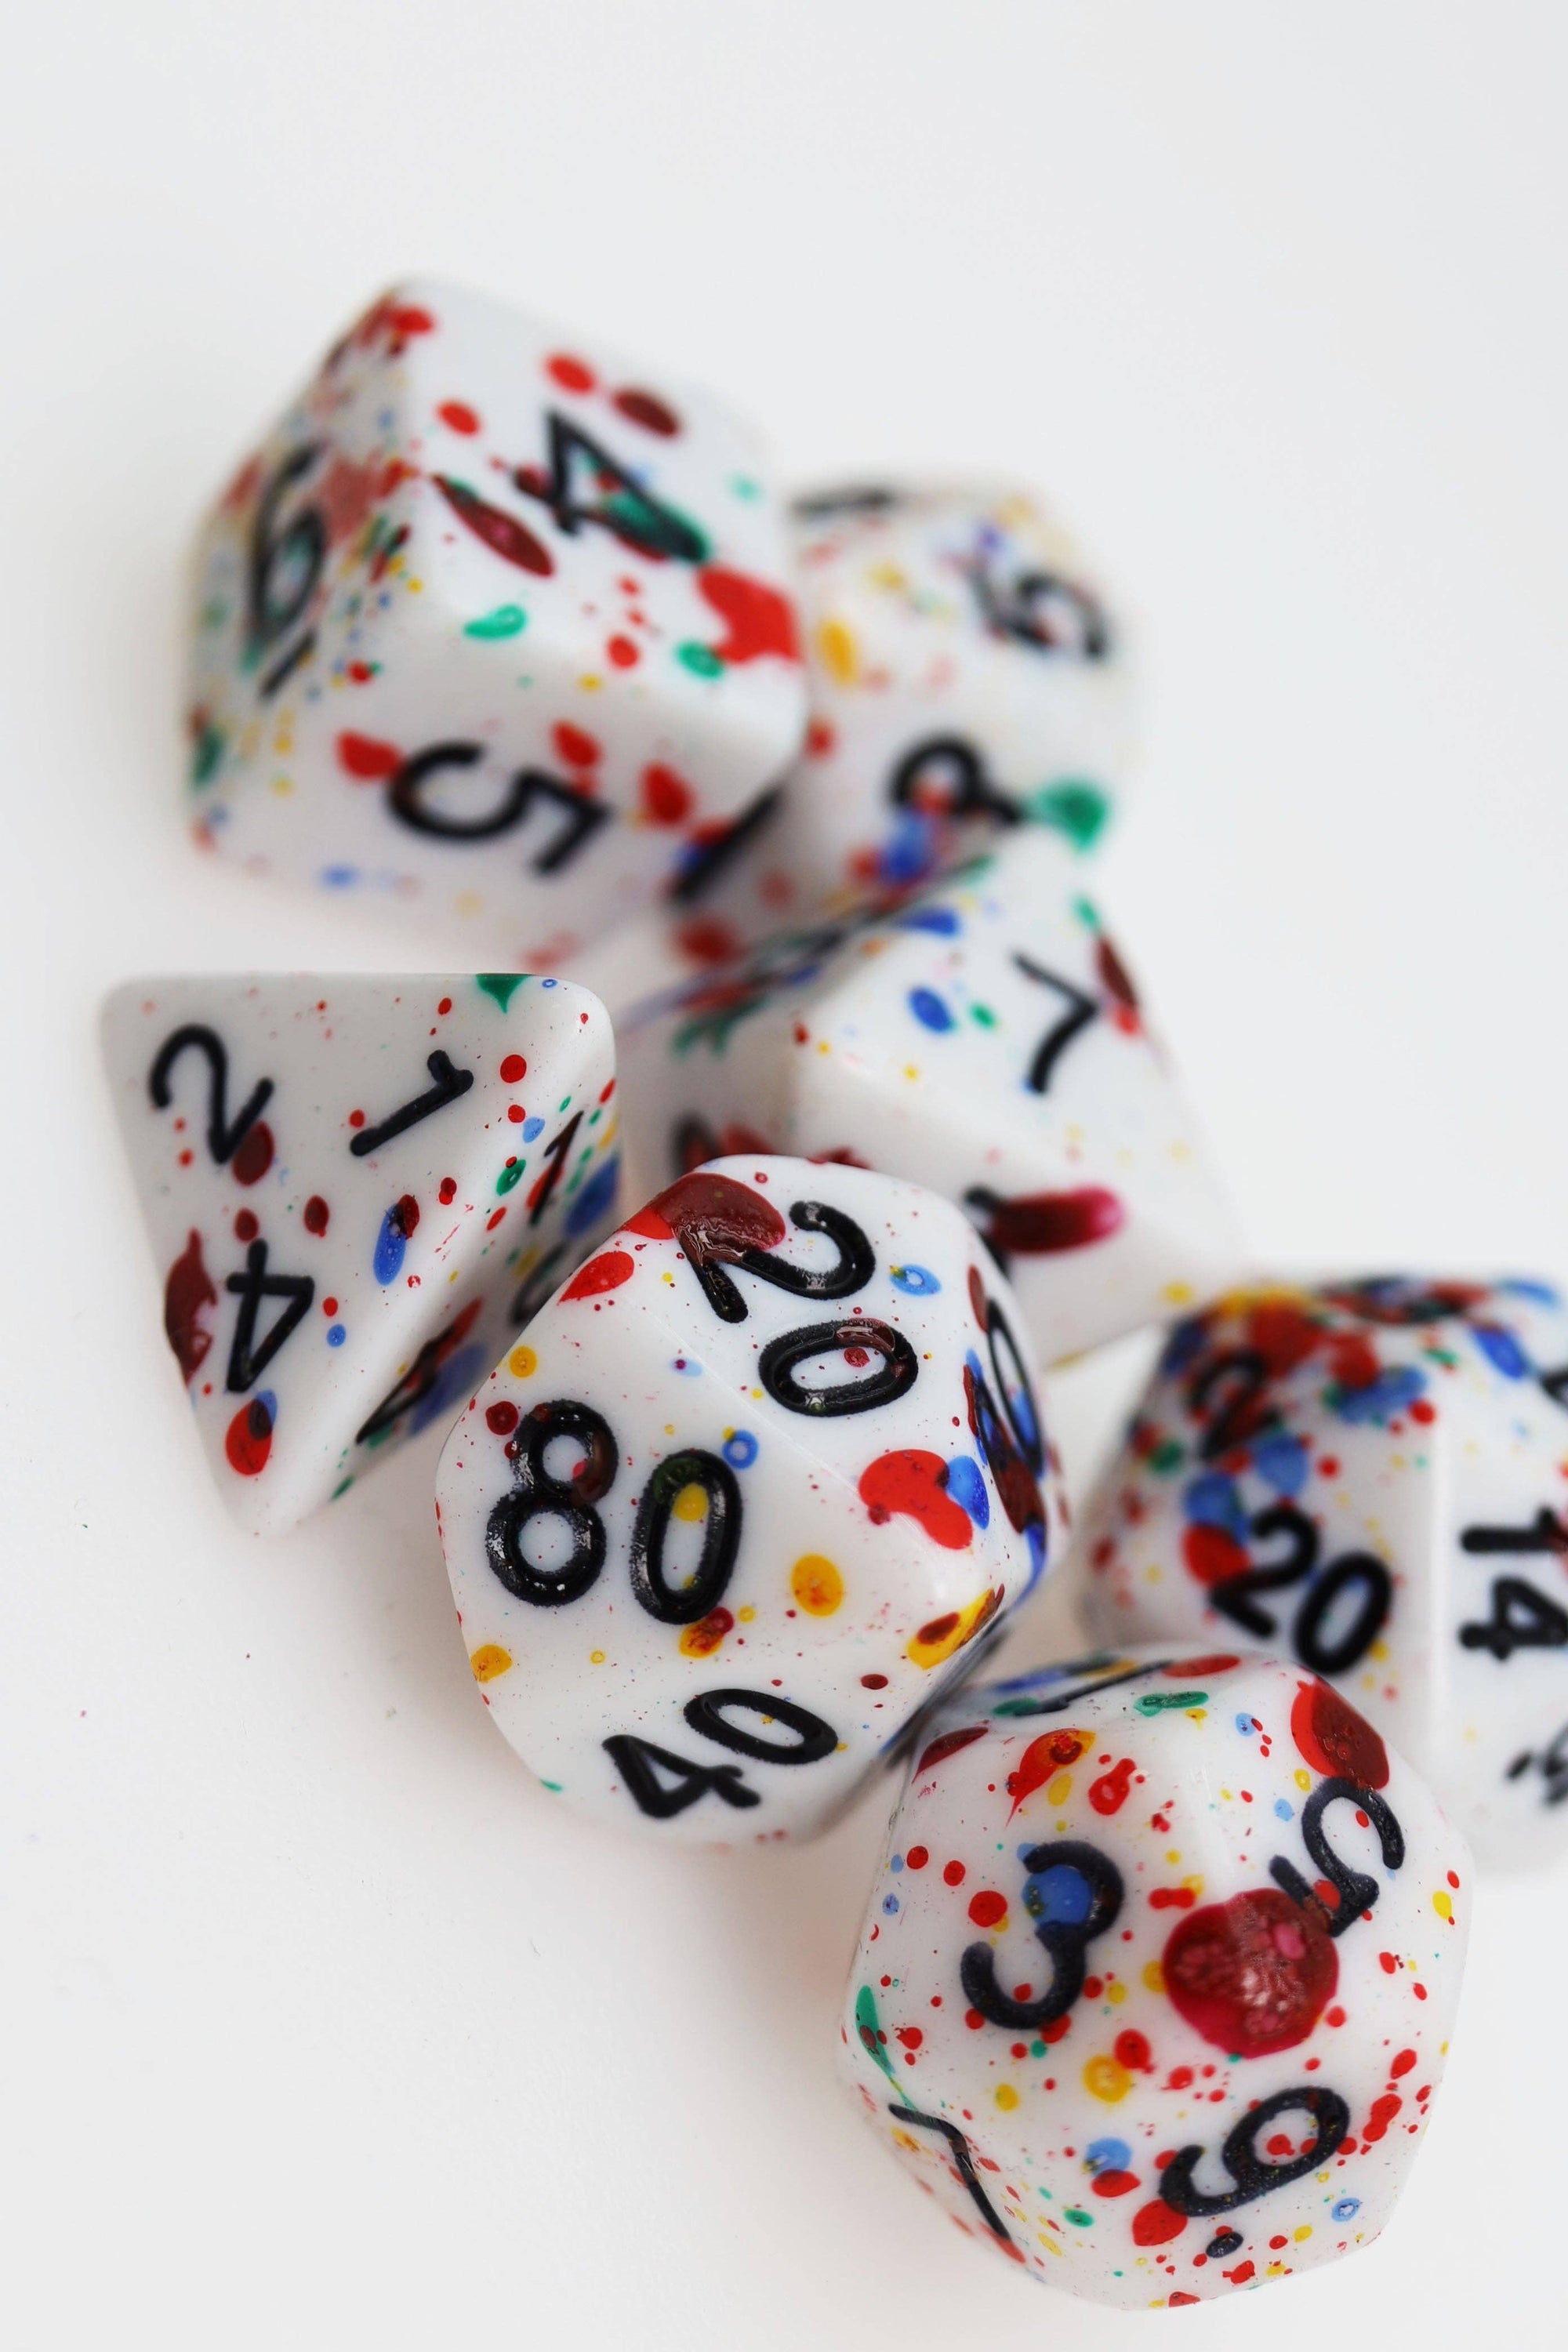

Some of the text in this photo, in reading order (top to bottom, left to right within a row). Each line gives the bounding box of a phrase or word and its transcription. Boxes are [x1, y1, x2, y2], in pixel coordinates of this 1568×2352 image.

[513, 409, 709, 566] 4
[386, 739, 613, 878] 5
[149, 1024, 274, 1165] 2
[1011, 950, 1101, 1094] 7
[350, 1049, 474, 1157] 1
[224, 1239, 315, 1393] 4
[674, 1200, 920, 1417] 20
[485, 1399, 744, 1624] 80
[1458, 1505, 1568, 1661] 14
[1209, 1504, 1393, 1675] 20
[601, 1688, 839, 1819] 40
[960, 1838, 1125, 2031] 3
[1269, 1776, 1406, 1938] 5
[887, 2103, 1013, 2244] 7
